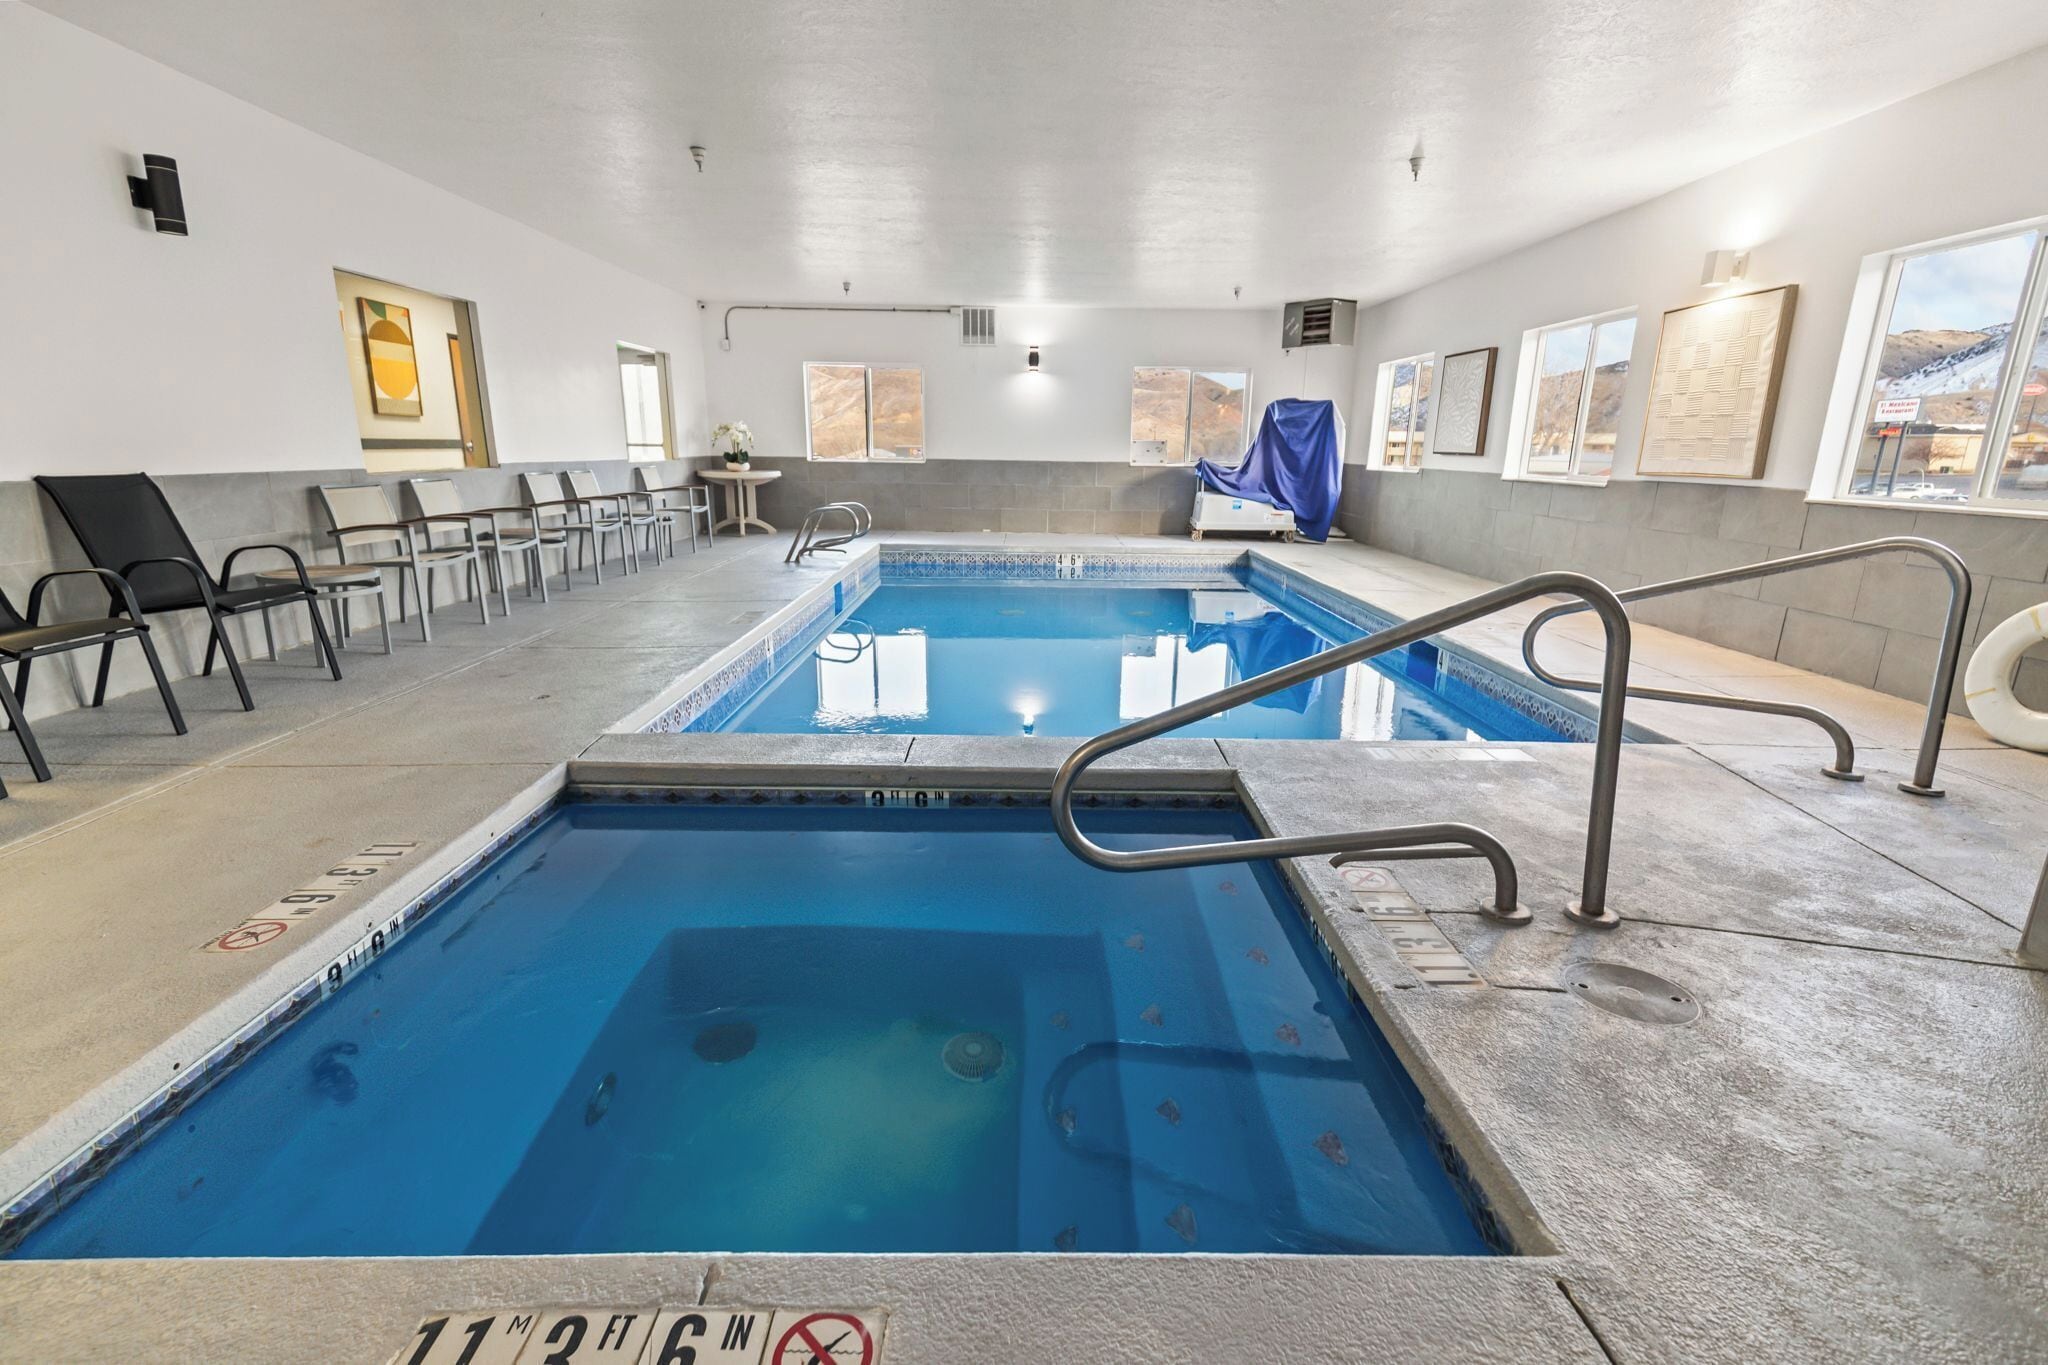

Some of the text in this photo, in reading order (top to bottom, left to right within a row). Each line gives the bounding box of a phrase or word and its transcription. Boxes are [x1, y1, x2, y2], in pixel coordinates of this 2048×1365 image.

[1071, 554, 1076, 566] 6
[325, 867, 378, 877] 3
[280, 894, 337, 904] 6
[1392, 937, 1451, 949] 3
[506, 1314, 534, 1335] M
[543, 1315, 589, 1365] 3
[597, 1314, 639, 1351] FT
[656, 1314, 708, 1365] 6
[720, 1314, 756, 1351] IN
